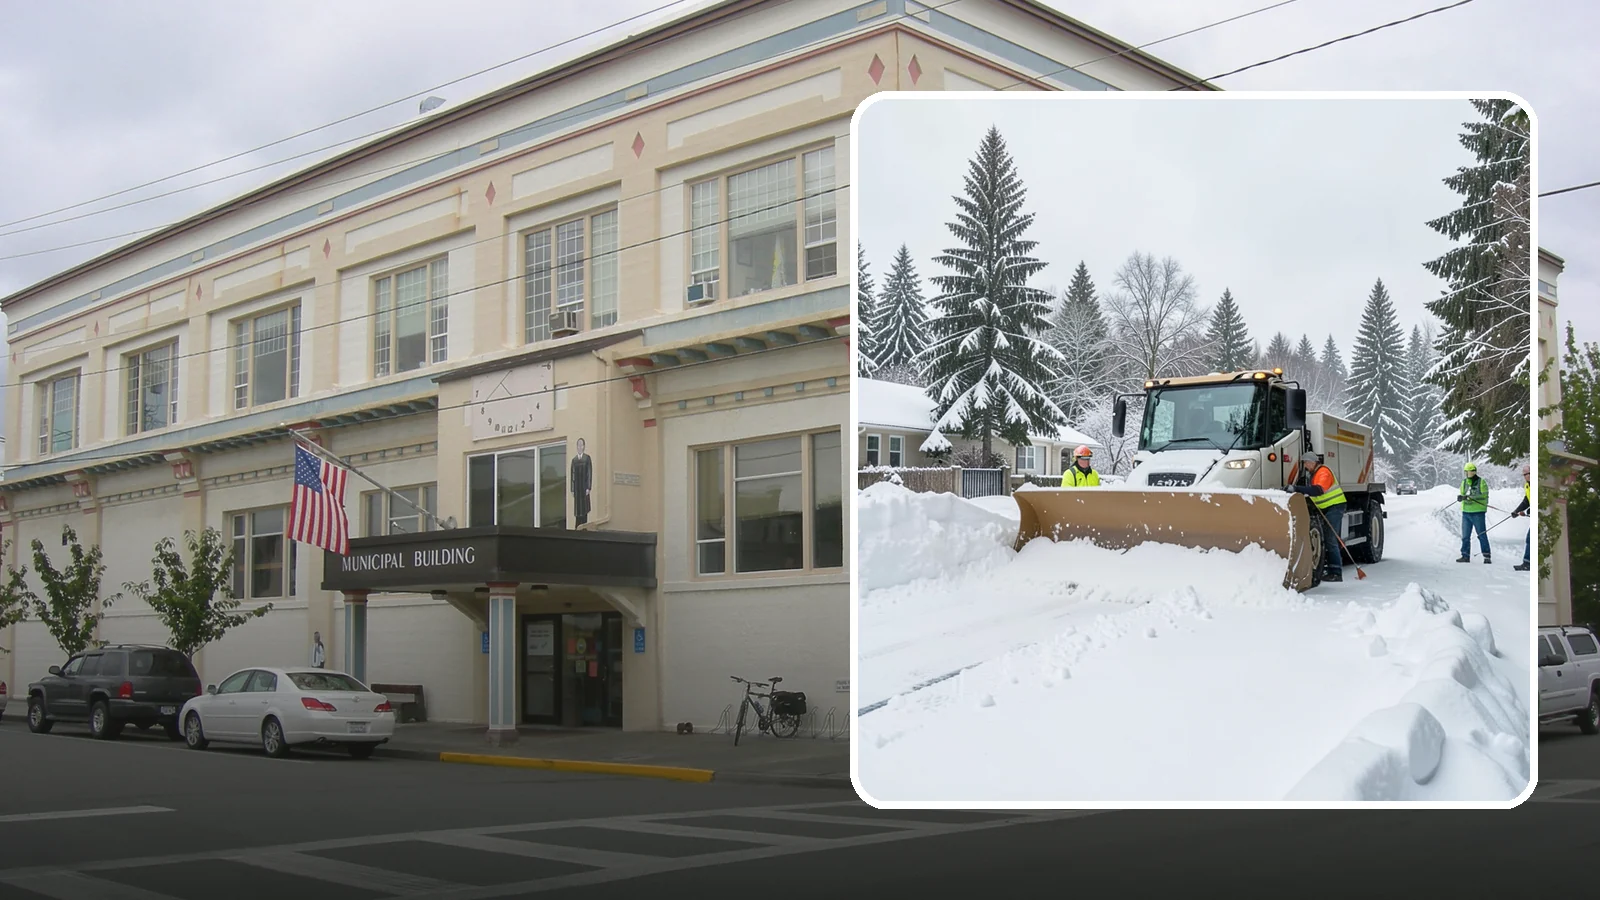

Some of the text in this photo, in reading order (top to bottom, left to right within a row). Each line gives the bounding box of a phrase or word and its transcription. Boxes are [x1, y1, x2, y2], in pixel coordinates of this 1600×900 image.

[480, 407, 485, 415] 8
[487, 418, 493, 426] 9
[342, 546, 475, 572] MUNICIPAL BUILDING
